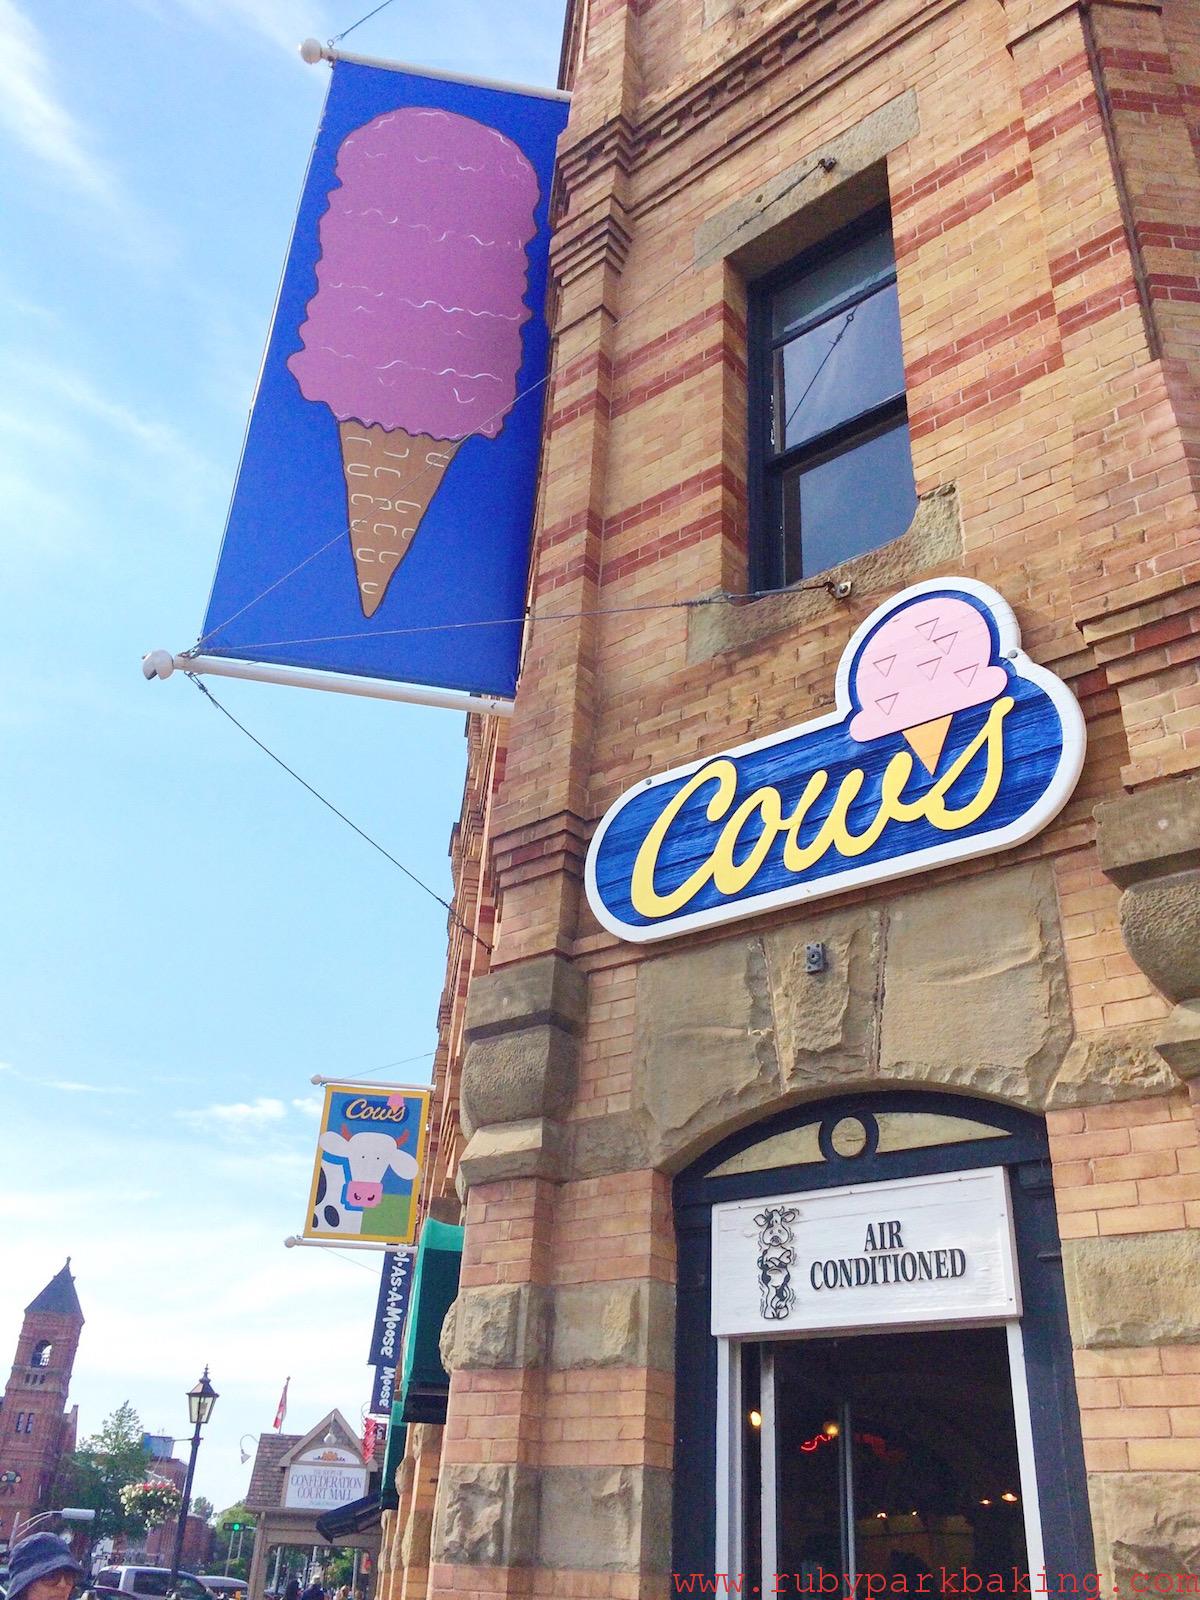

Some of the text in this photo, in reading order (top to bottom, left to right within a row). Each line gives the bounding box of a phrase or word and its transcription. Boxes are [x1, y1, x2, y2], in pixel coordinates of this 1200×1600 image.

[631, 697, 1014, 917] Cows
[346, 1098, 406, 1122] Cows
[864, 1220, 904, 1251] AIR
[810, 1248, 967, 1290] CONDITIONED
[379, 1366, 396, 1408] Moose
[290, 1474, 363, 1489] CONFEDERATION
[297, 1486, 353, 1501] COURT MALL
